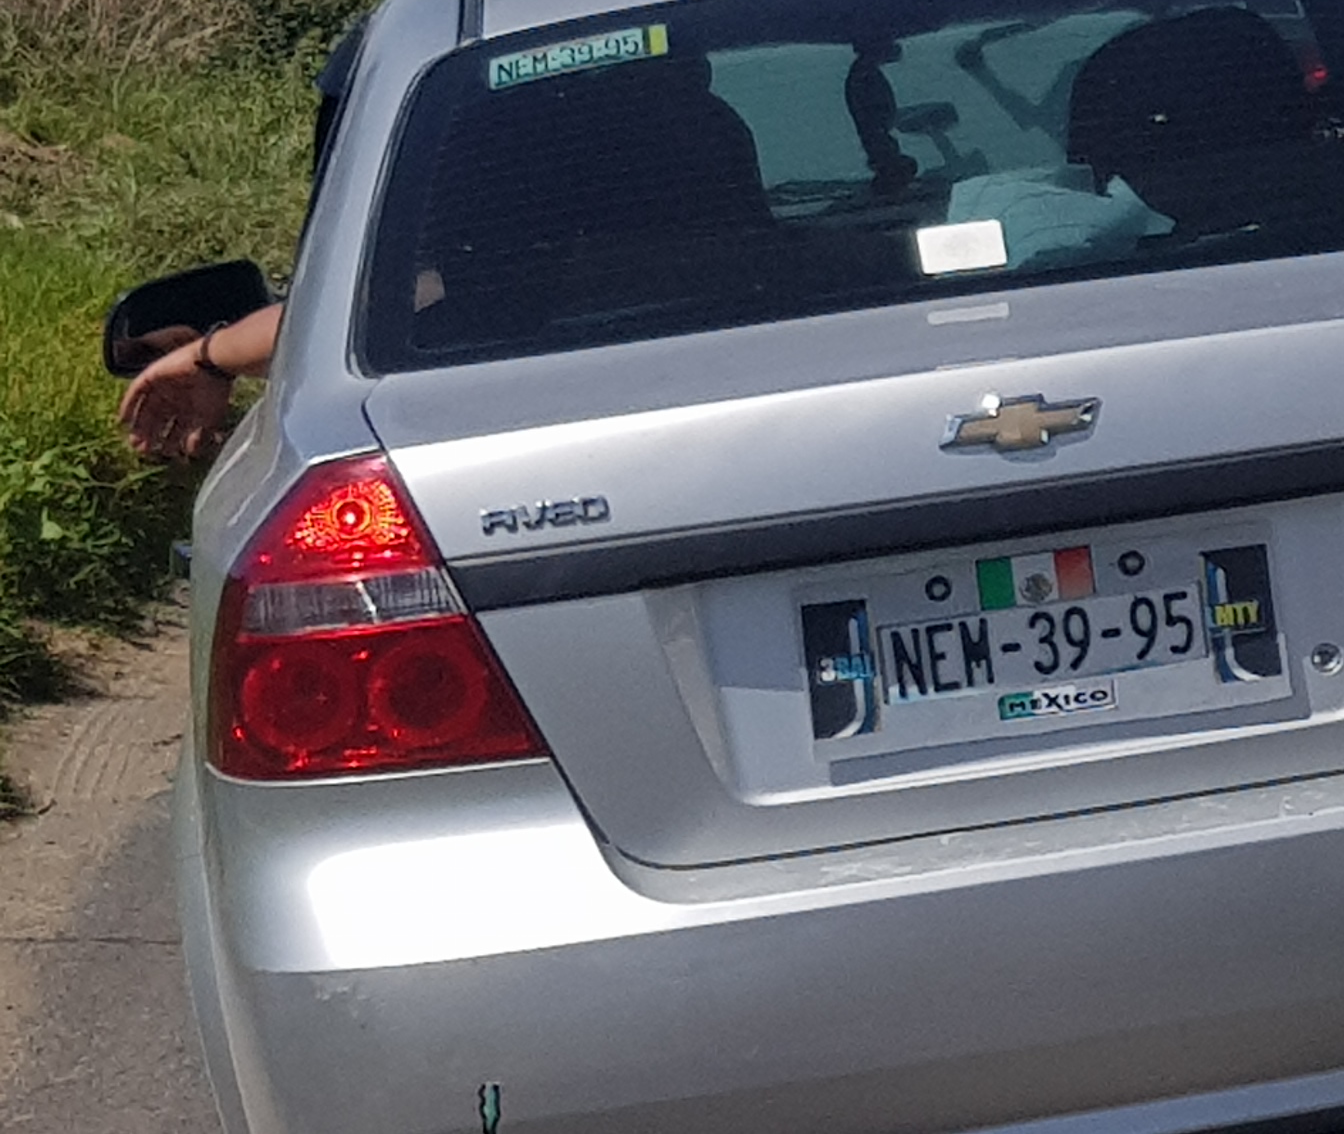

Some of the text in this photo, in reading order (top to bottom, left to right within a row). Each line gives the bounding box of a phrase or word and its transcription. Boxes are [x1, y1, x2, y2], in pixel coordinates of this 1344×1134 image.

[495, 33, 640, 85] NEM-39-95
[890, 591, 1195, 698] NEM-39-95
[1008, 690, 1109, 713] MEXICO
